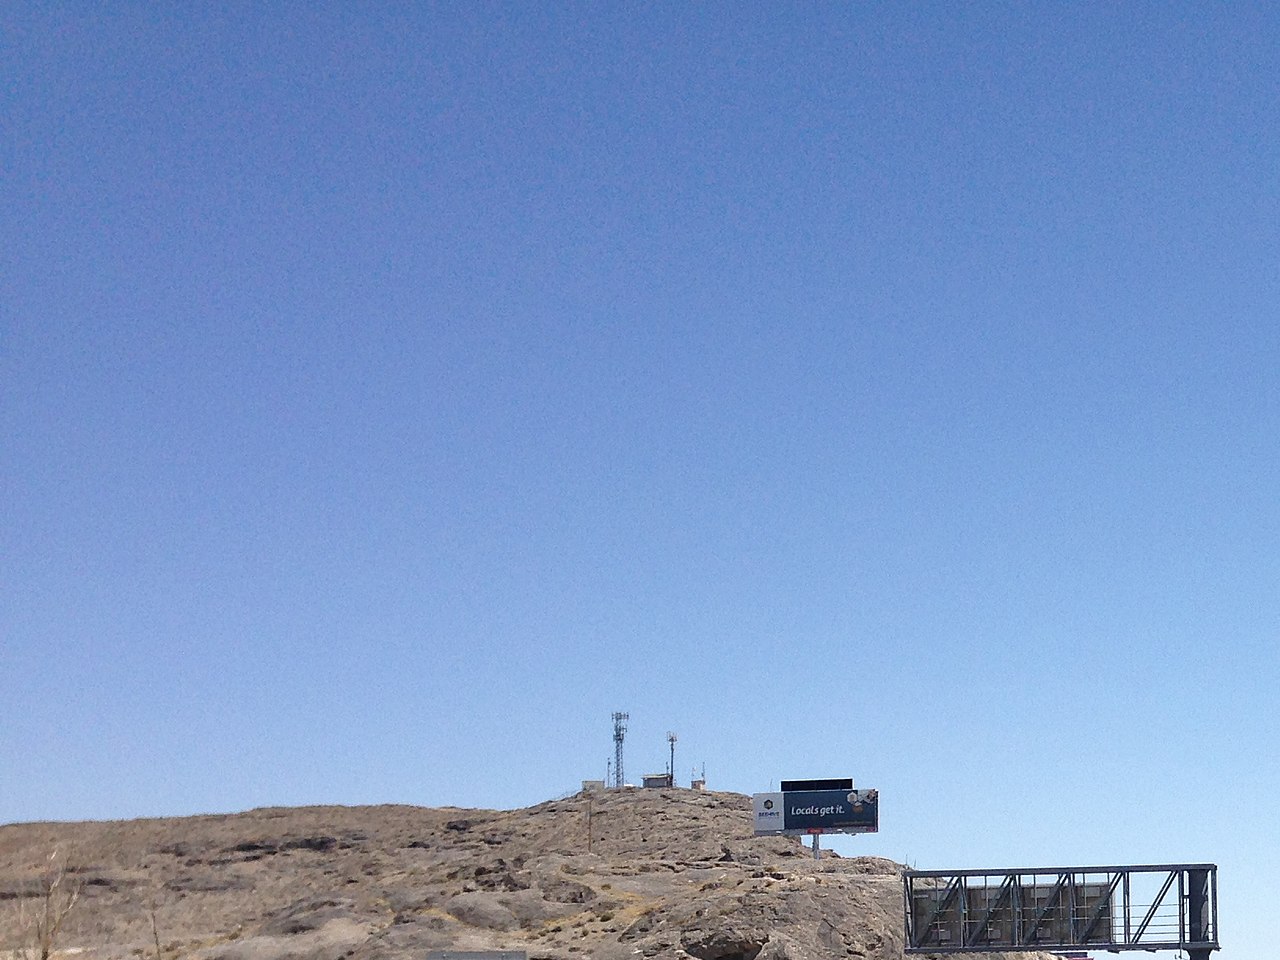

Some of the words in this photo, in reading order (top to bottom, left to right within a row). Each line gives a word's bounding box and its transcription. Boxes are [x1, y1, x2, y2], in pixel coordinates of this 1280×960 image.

[791, 805, 819, 816] Locals
[820, 806, 834, 817] get
[835, 804, 845, 814] it.
